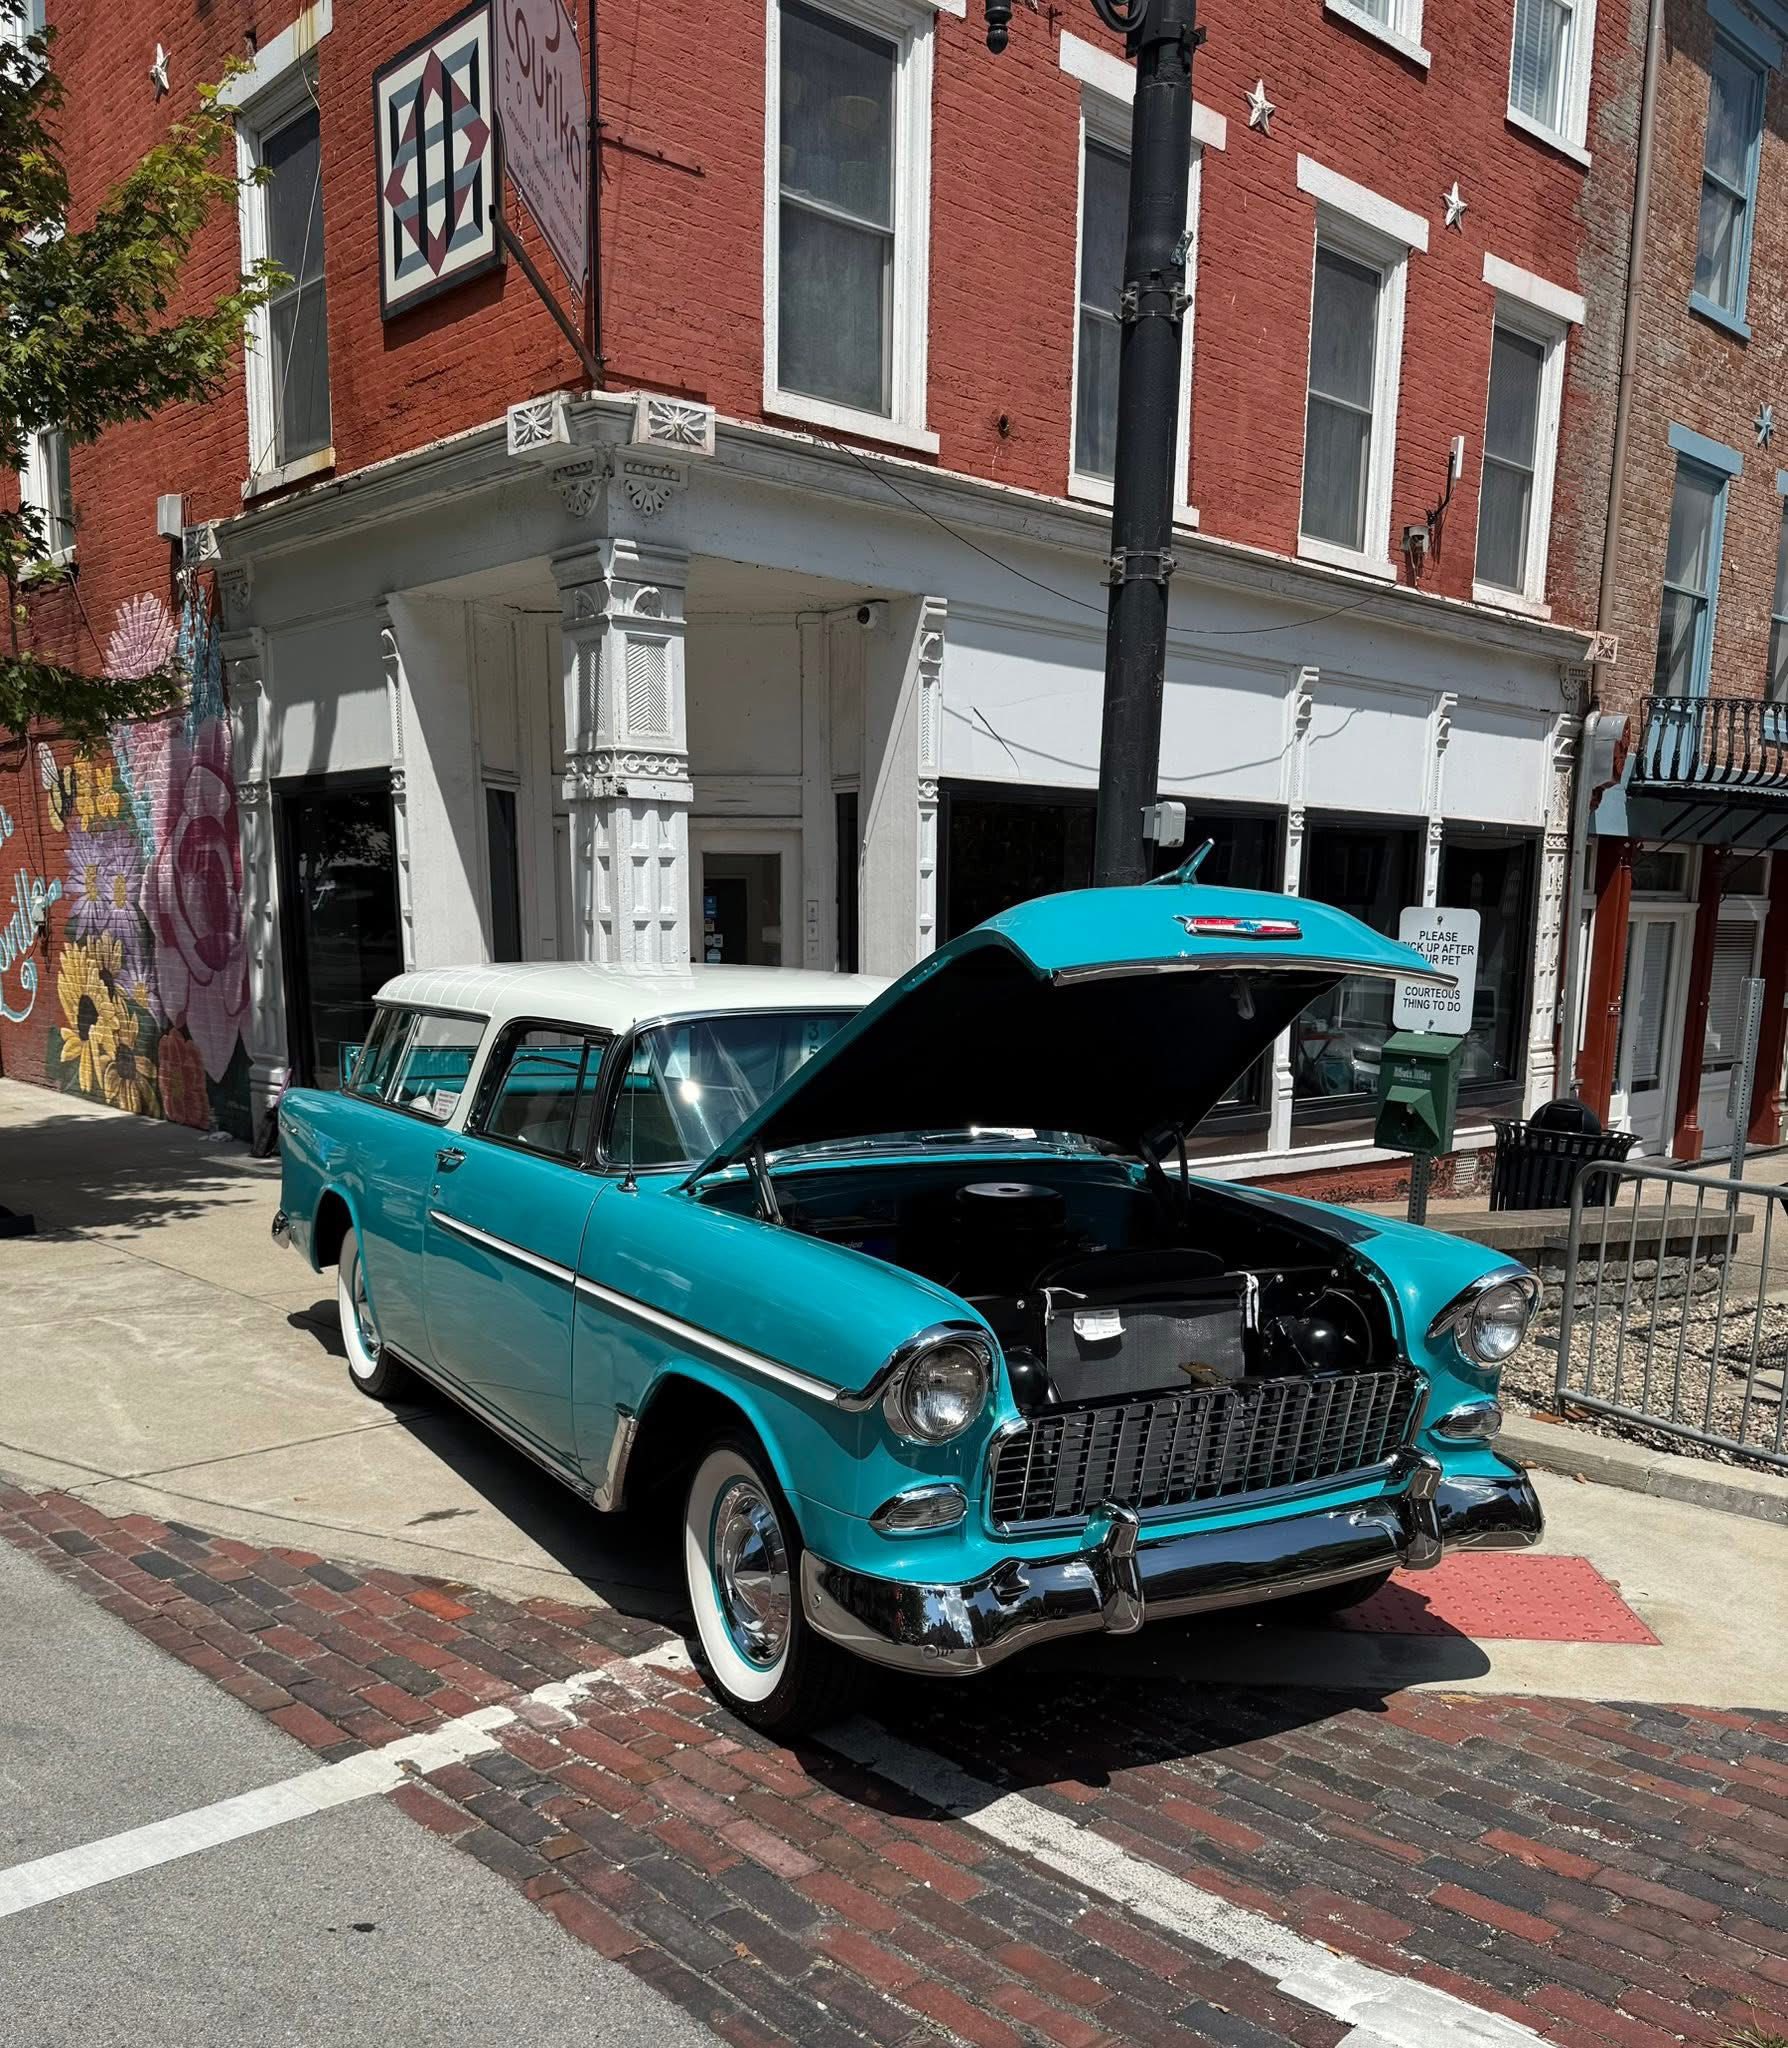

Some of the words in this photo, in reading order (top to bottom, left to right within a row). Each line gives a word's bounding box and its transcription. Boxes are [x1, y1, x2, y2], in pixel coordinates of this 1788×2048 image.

[1419, 931, 1458, 942] PLEASE
[1426, 942, 1440, 952] UP
[1442, 944, 1475, 955] AFTER
[1441, 955, 1461, 965] PET
[1405, 986, 1461, 999] COURTEOUS
[1403, 998, 1430, 1010] THING
[1433, 1000, 1445, 1010] TO
[1447, 1001, 1461, 1012] DO
